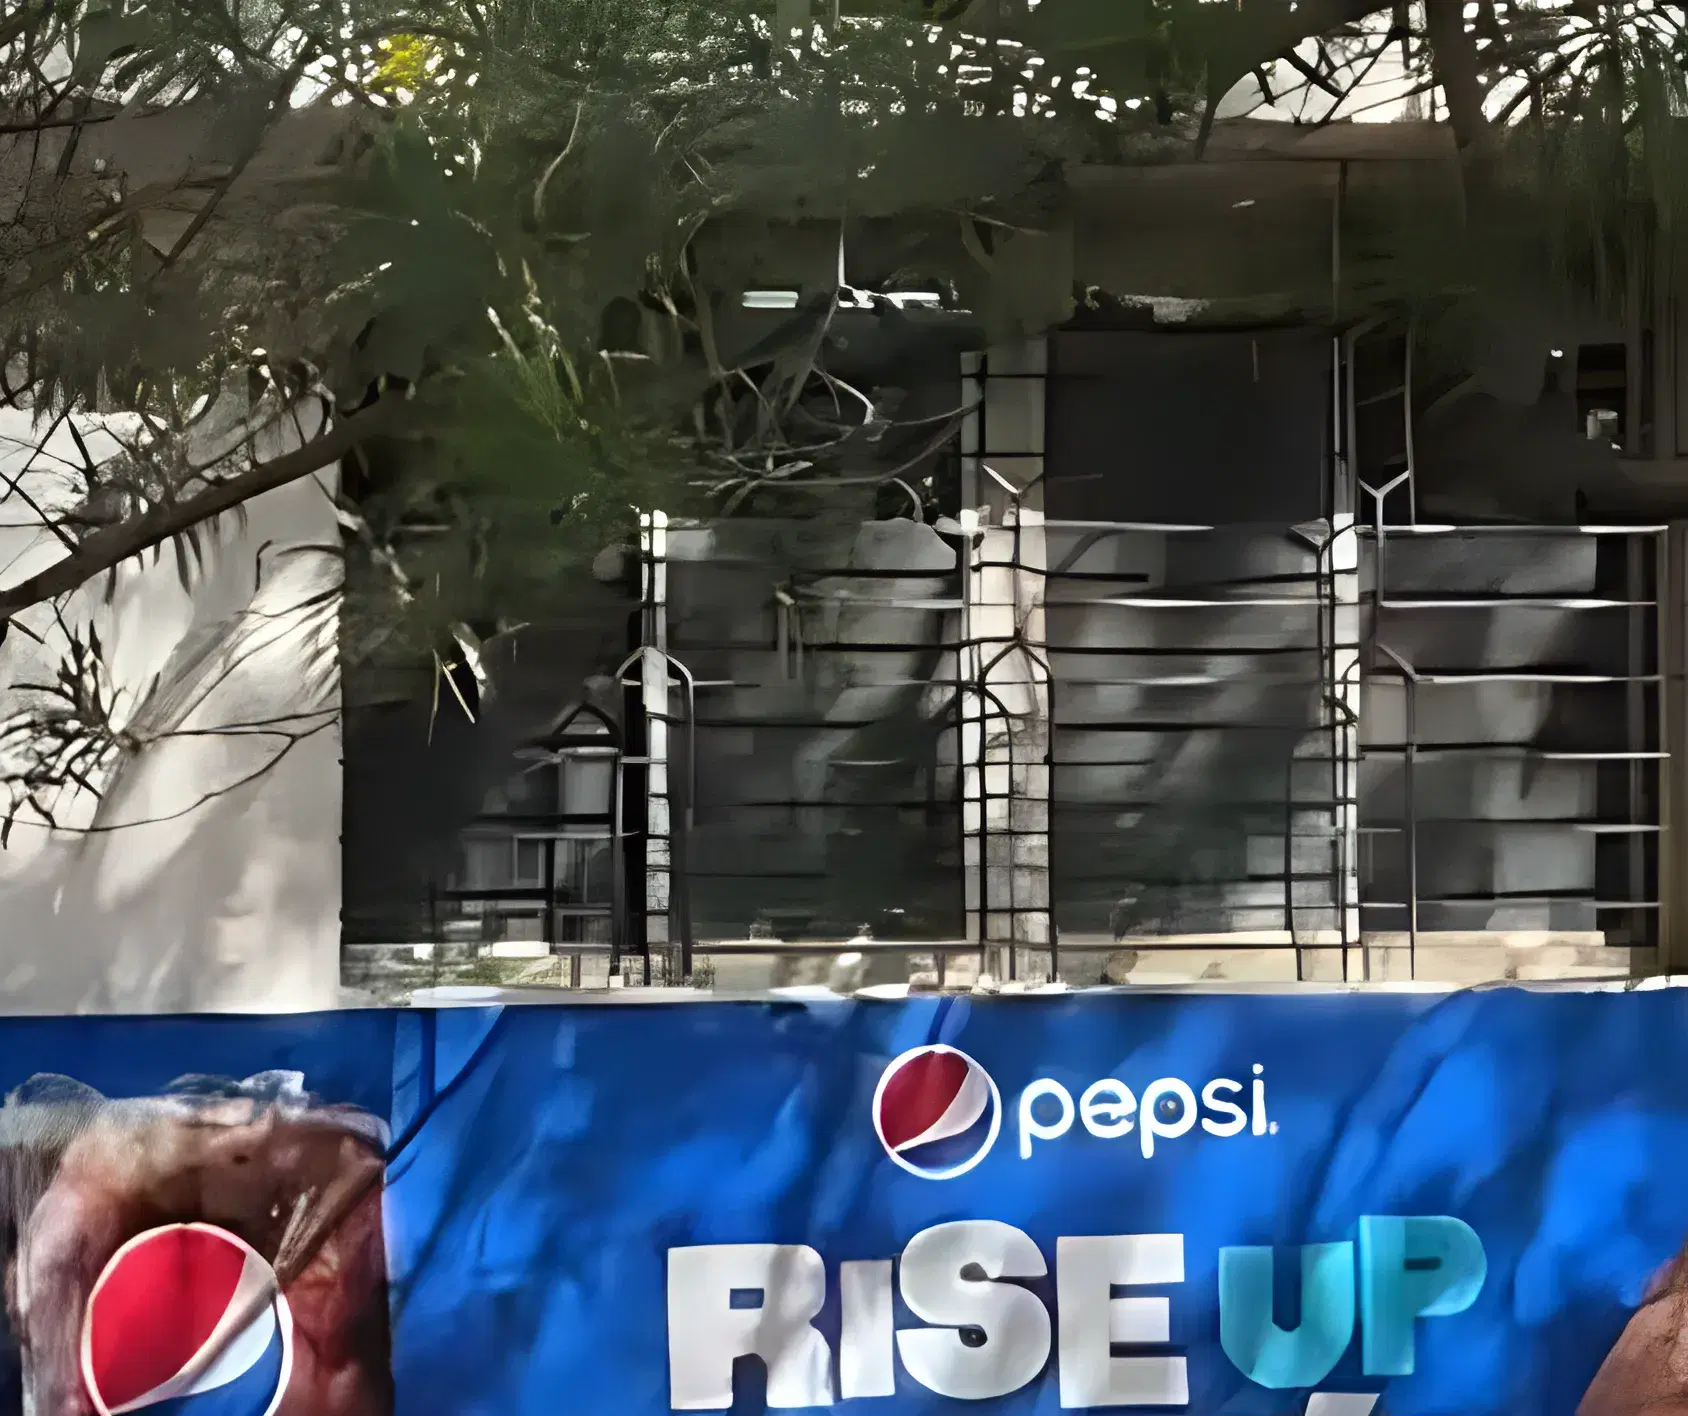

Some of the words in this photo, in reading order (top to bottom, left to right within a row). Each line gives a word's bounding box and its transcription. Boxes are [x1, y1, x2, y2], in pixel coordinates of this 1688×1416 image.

[1019, 1063, 1270, 1159] pepsi
[667, 1218, 1190, 1410] RISE
[1218, 1214, 1488, 1388] UP
